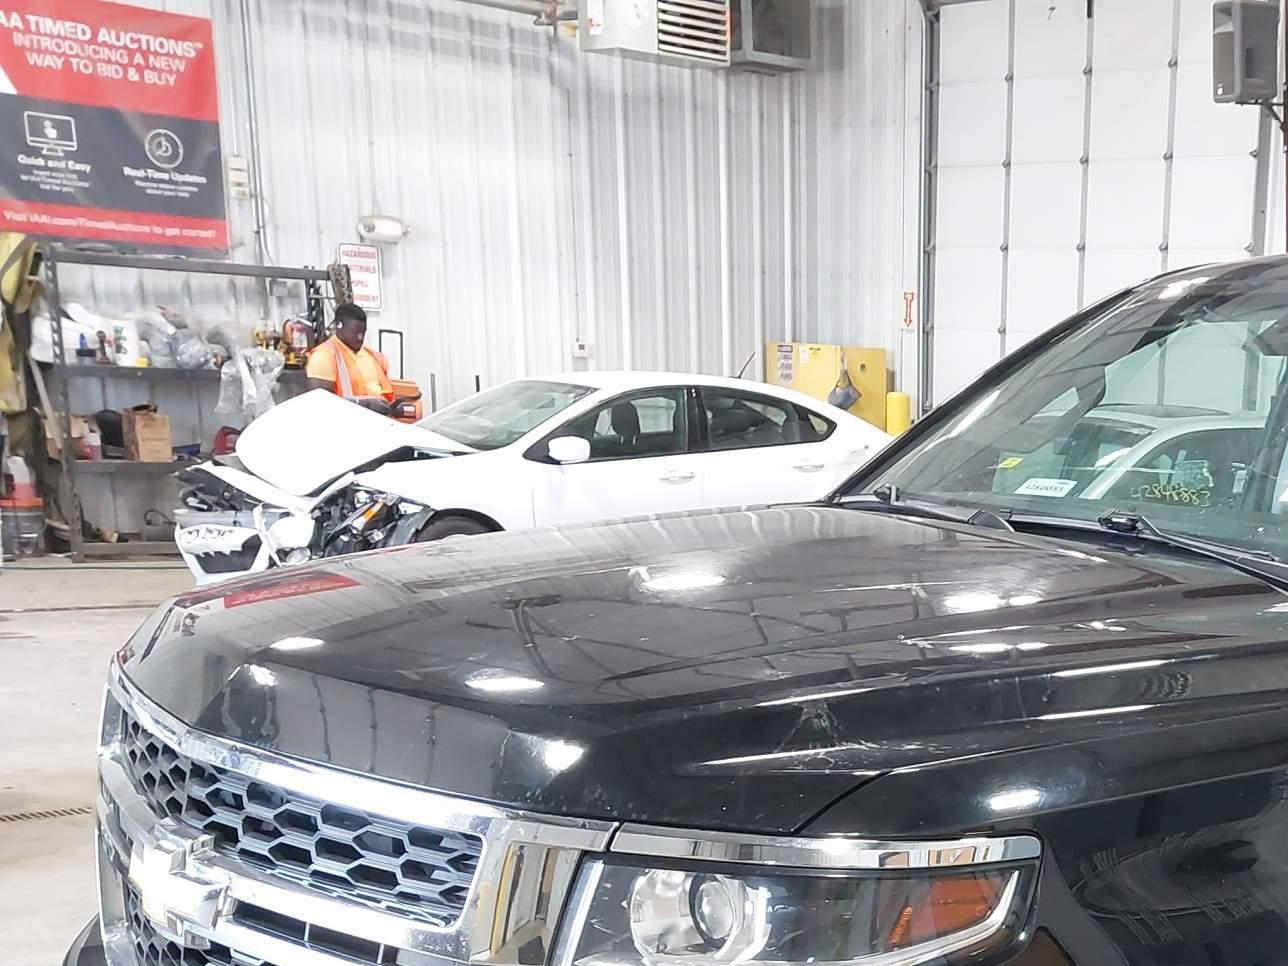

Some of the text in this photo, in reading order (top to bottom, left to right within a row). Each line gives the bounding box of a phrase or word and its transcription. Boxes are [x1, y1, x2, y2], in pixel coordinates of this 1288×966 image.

[25, 15, 92, 41] TIMED
[13, 31, 186, 73] INTRODUCING A NEW
[25, 51, 177, 87] WAY TO BID & BUY
[47, 159, 67, 169] and
[67, 160, 91, 174] Easy
[122, 166, 208, 184] Real-Time Updates
[3, 209, 28, 222] Visit
[152, 225, 163, 234] to
[164, 227, 180, 237] get
[342, 250, 377, 259] HAZARDOUS
[349, 265, 377, 273] ATERIALS
